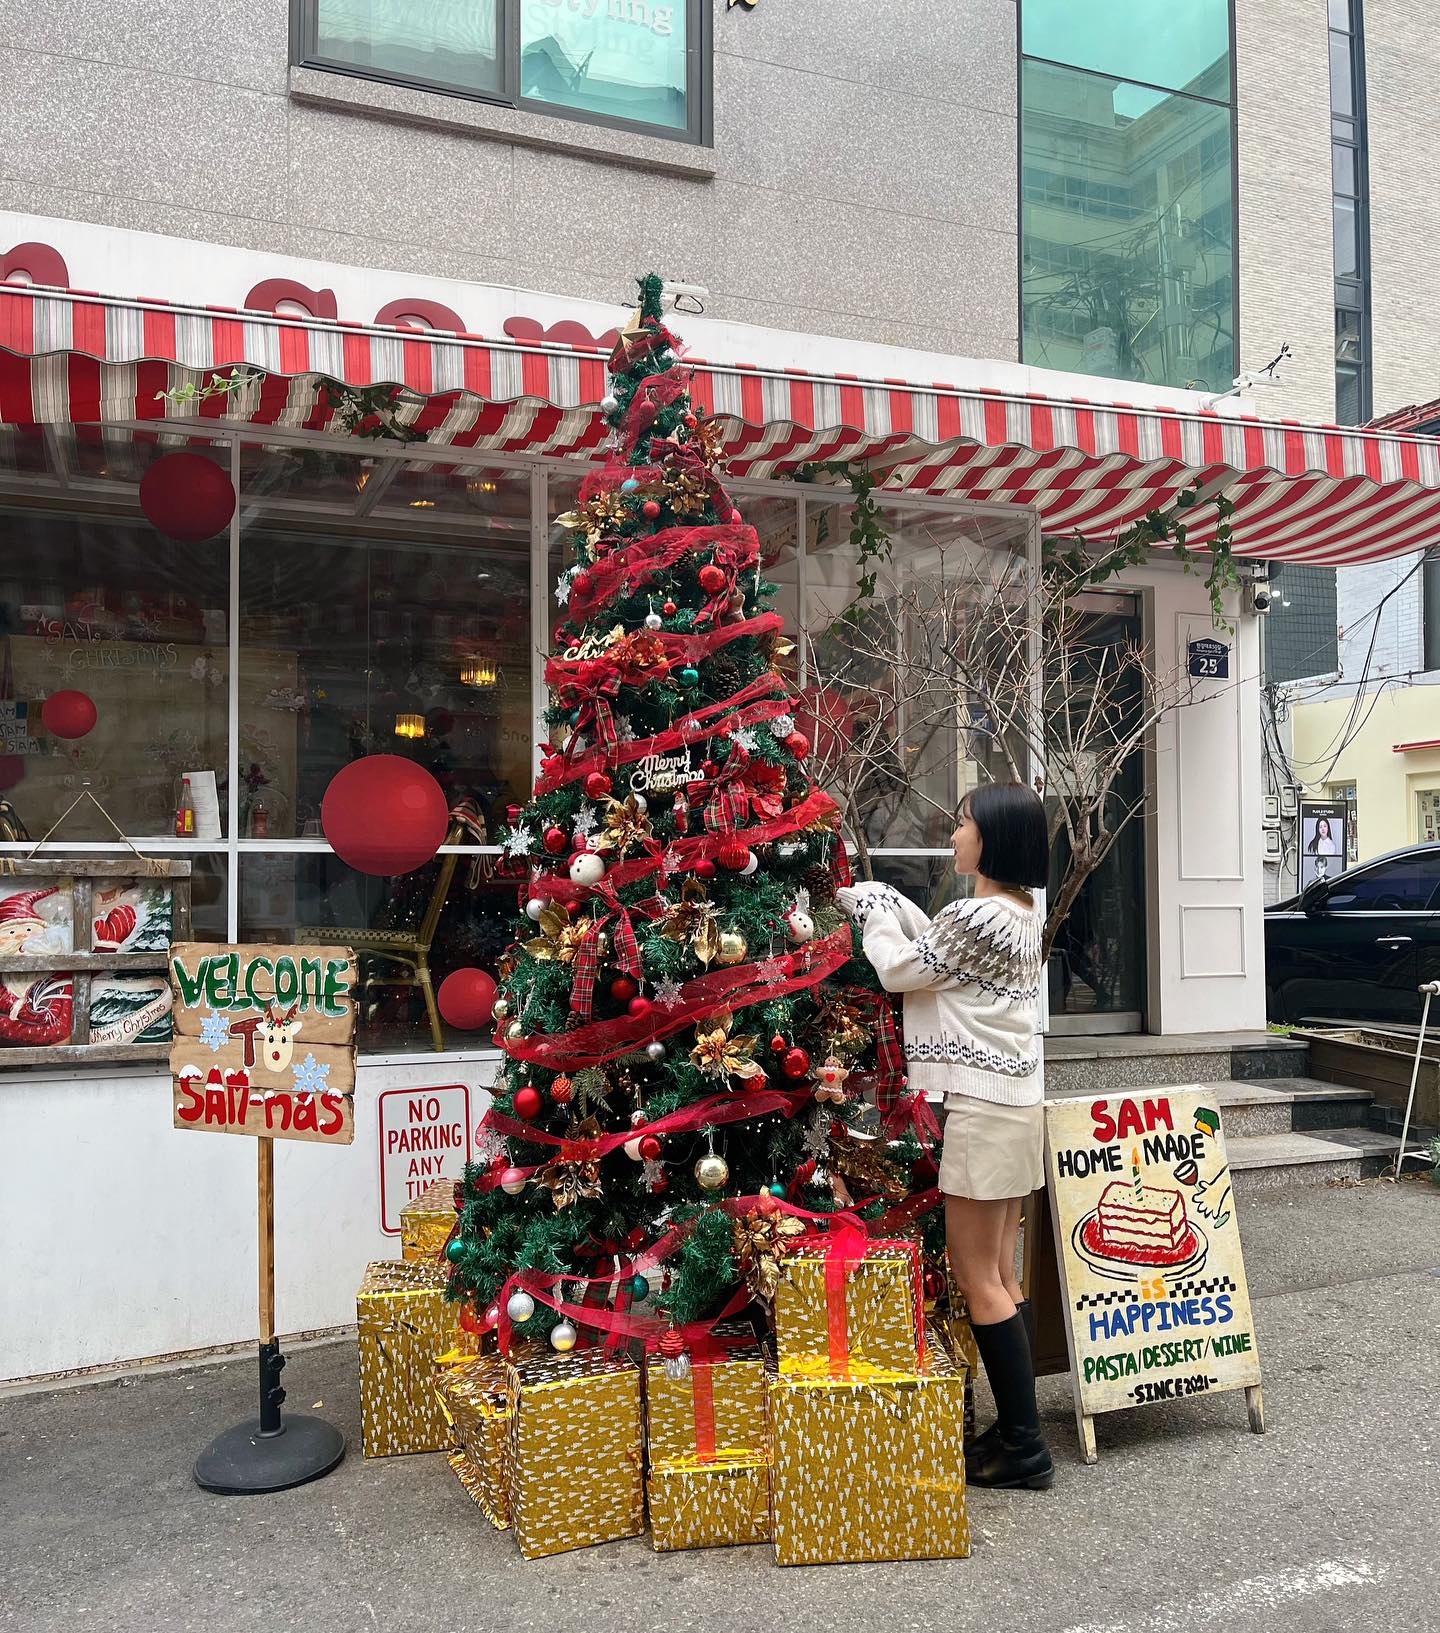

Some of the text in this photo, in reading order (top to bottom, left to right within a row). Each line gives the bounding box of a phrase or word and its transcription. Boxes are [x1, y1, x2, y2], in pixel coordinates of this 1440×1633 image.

[1199, 658, 1217, 674] 25
[8, 740, 39, 753] SAM
[638, 750, 691, 773] Merry
[630, 768, 705, 792] Christmas
[172, 953, 351, 1017] WELCOME
[91, 1027, 123, 1044] Merry
[408, 1097, 441, 1123] NO
[1090, 1097, 1175, 1143] SAM
[388, 1123, 462, 1155] PARKING
[408, 1155, 445, 1178] ANY
[1057, 1133, 1206, 1179] HOME MADE
[406, 1178, 447, 1200] TIM
[1089, 1294, 1234, 1342] HAPPINESS
